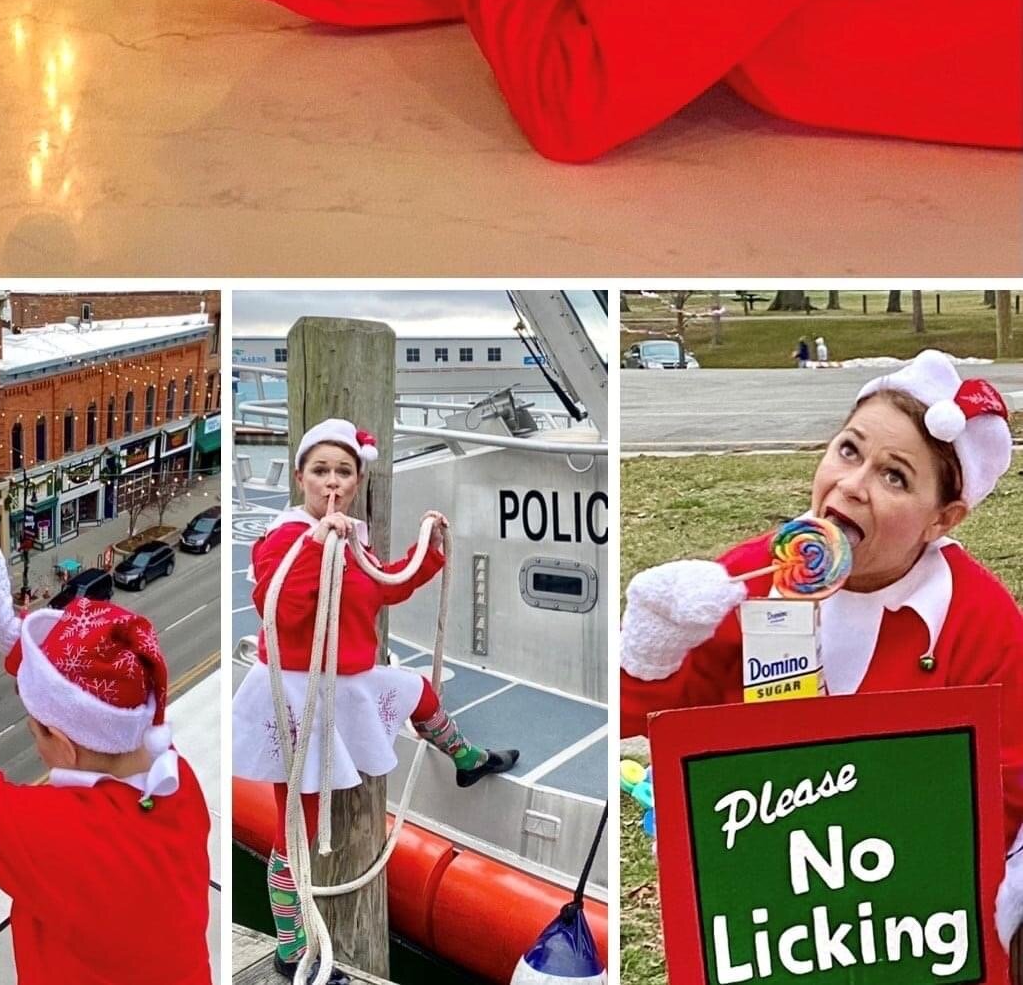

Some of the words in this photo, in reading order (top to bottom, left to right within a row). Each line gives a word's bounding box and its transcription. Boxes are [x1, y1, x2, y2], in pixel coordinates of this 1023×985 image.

[499, 490, 608, 545] POLIC
[748, 656, 808, 681] Domino
[757, 680, 801, 699] SUGAR
[714, 764, 858, 850] Please
[789, 825, 895, 895] No
[713, 901, 969, 985] Licking
